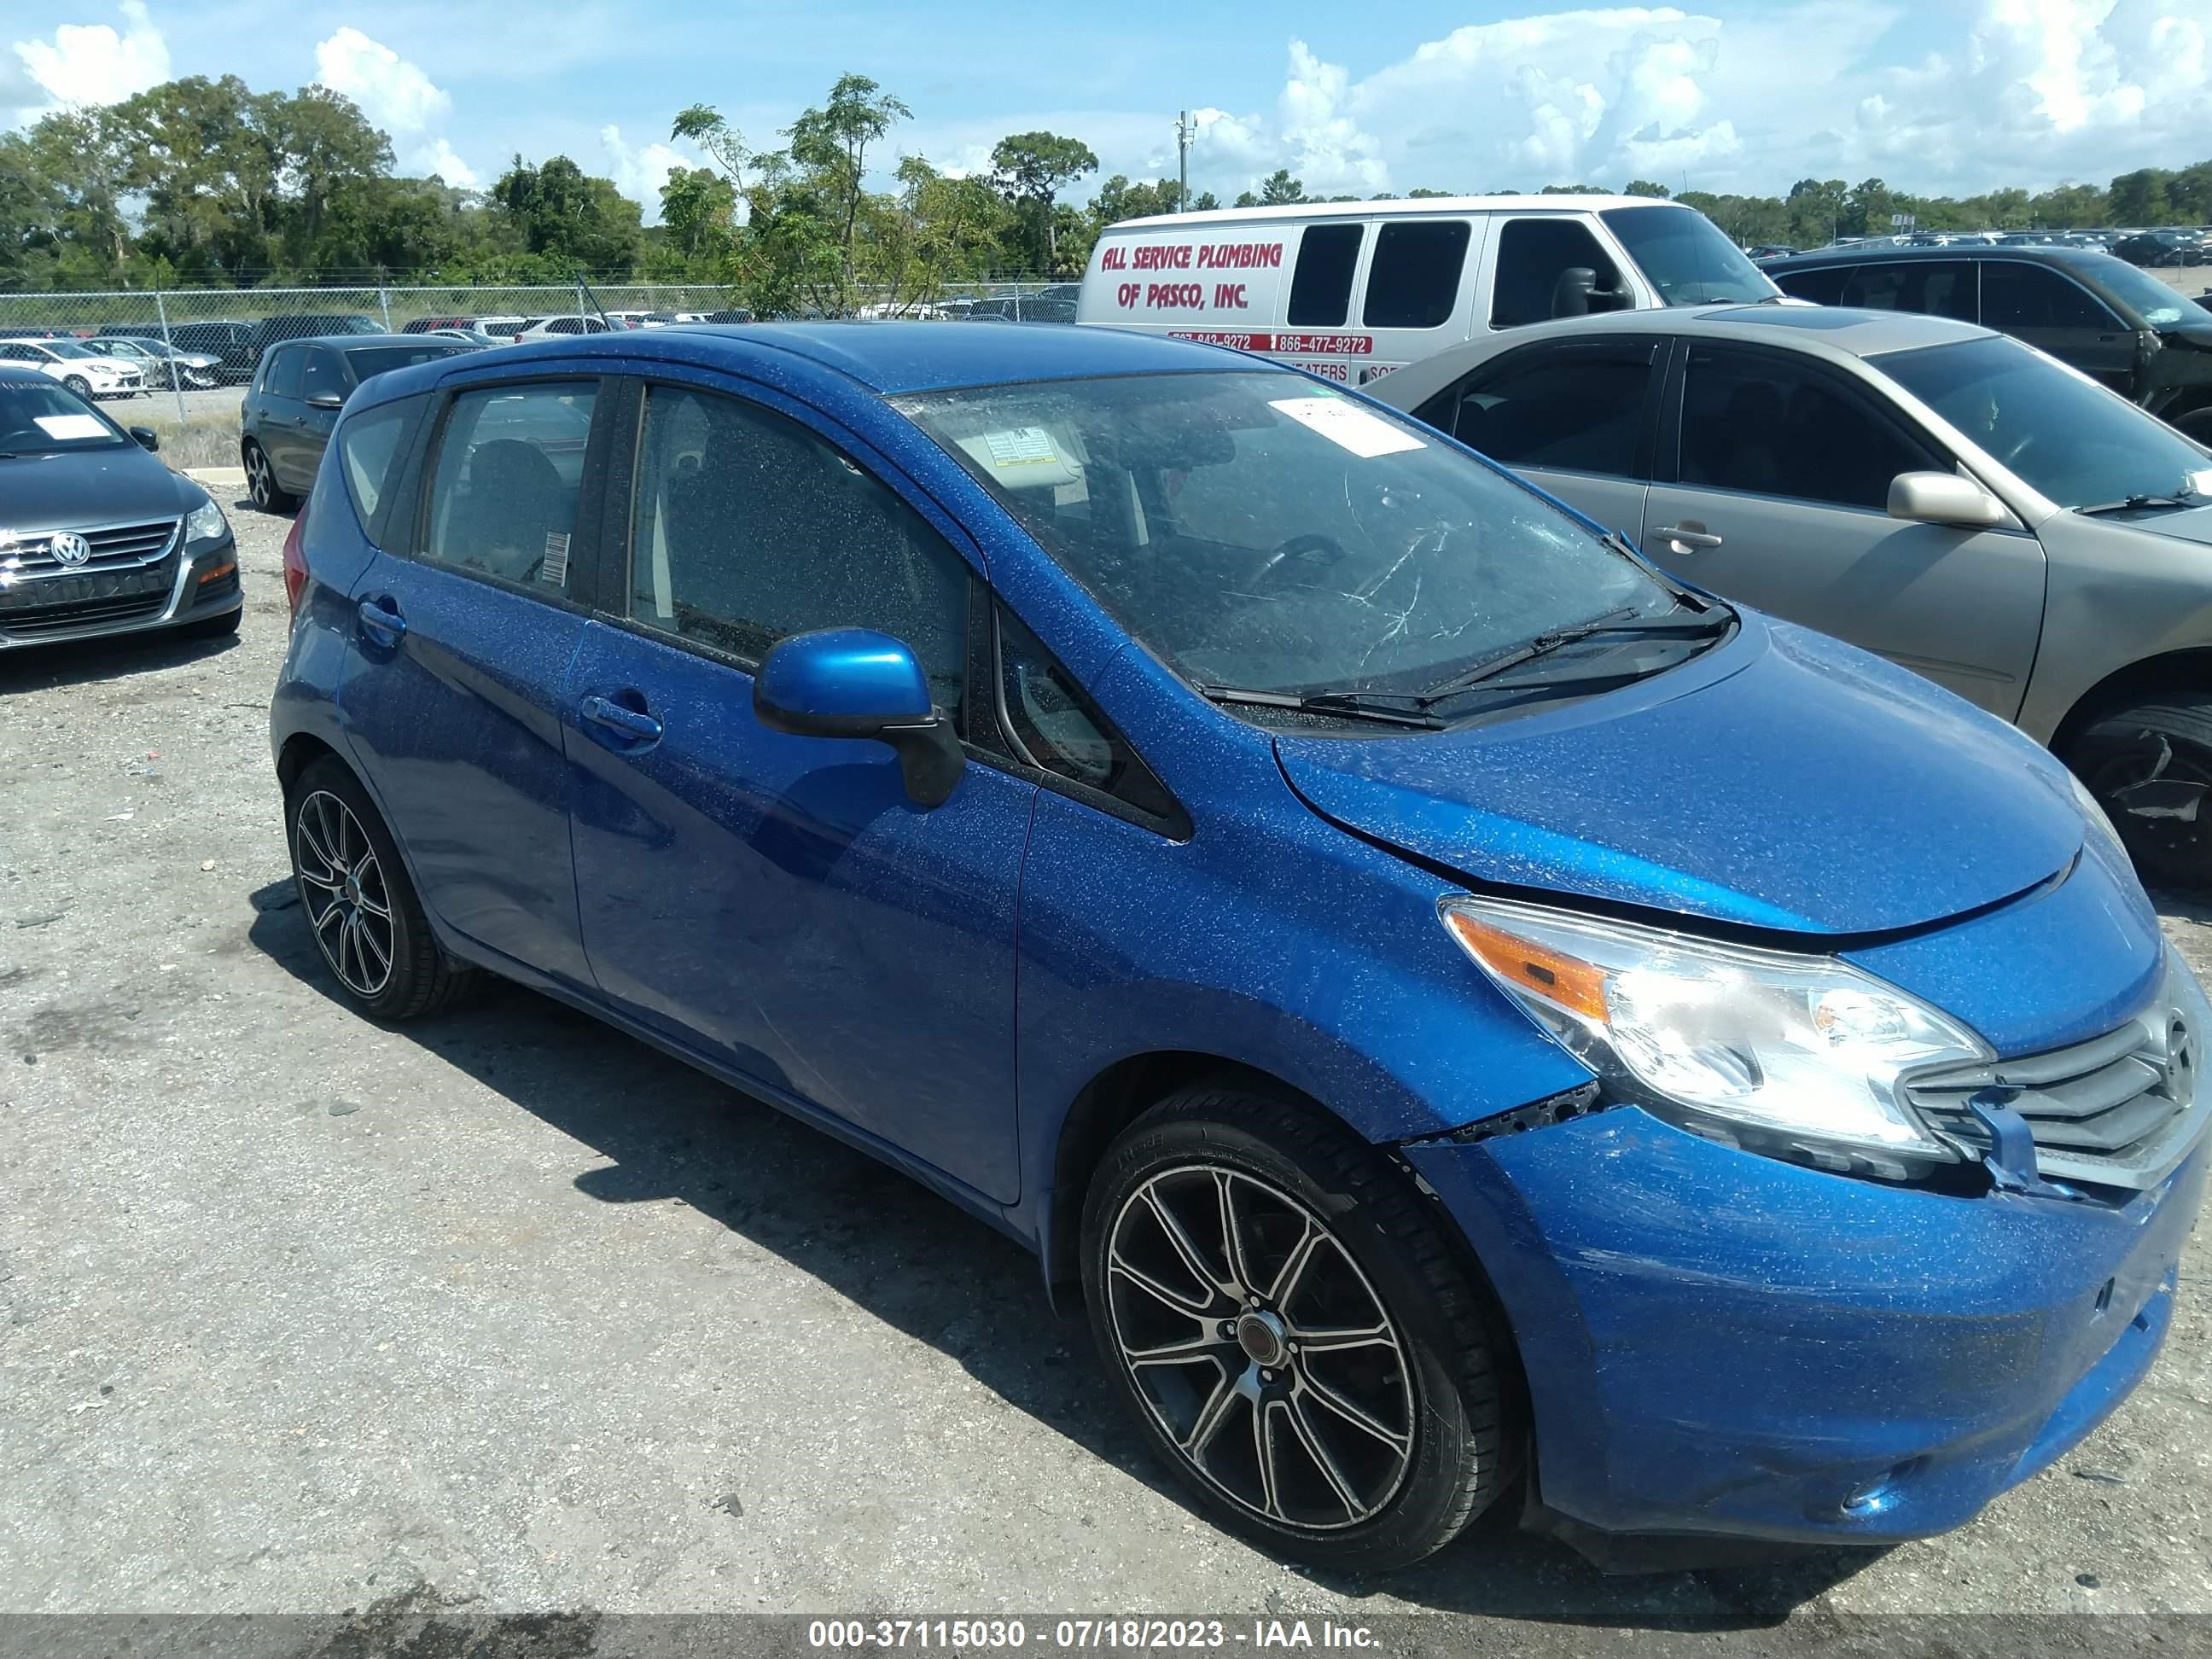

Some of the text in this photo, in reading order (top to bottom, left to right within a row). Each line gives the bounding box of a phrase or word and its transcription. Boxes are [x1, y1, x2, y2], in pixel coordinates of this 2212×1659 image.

[1102, 242, 1284, 273] ALL SERVICE PLUMBING
[1117, 282, 1249, 311] OF PASCO, INC.
[1279, 335, 1365, 353] 866-477-9272
